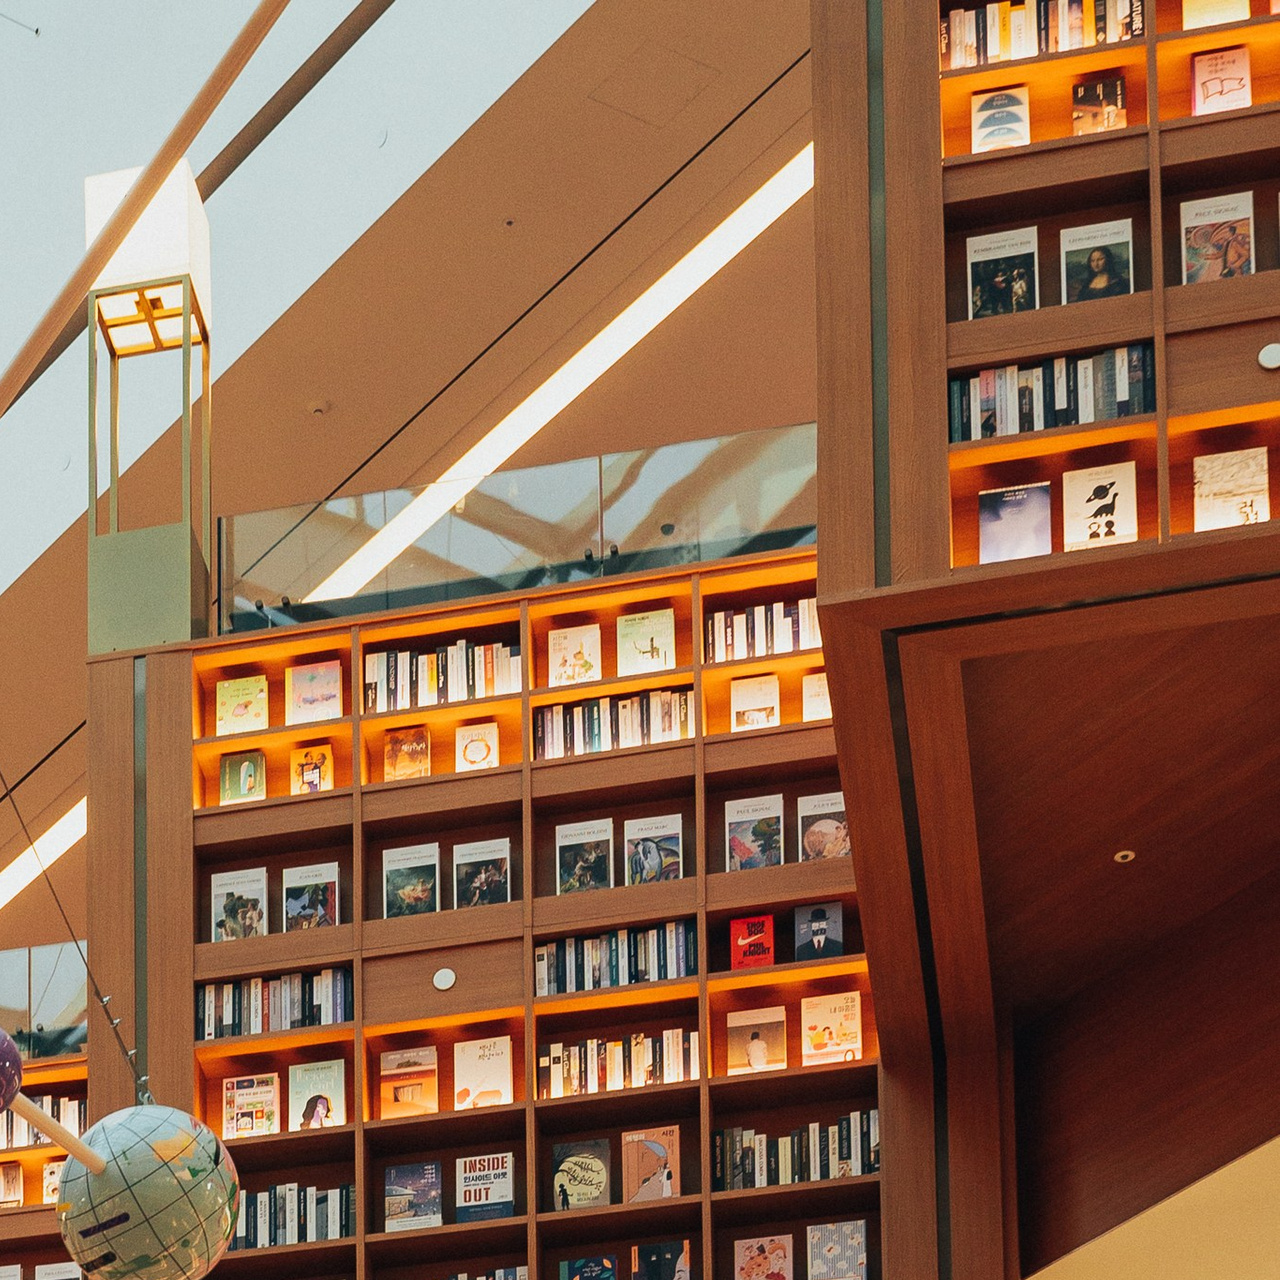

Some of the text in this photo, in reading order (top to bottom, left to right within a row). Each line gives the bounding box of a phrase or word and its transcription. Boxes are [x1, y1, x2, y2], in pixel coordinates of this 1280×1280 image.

[747, 928, 765, 937] DOG
[742, 946, 770, 958] KNIGHT
[463, 1155, 508, 1175] INSIDE
[463, 1174, 497, 1184] 인사이드
[463, 1187, 496, 1204] OUT
